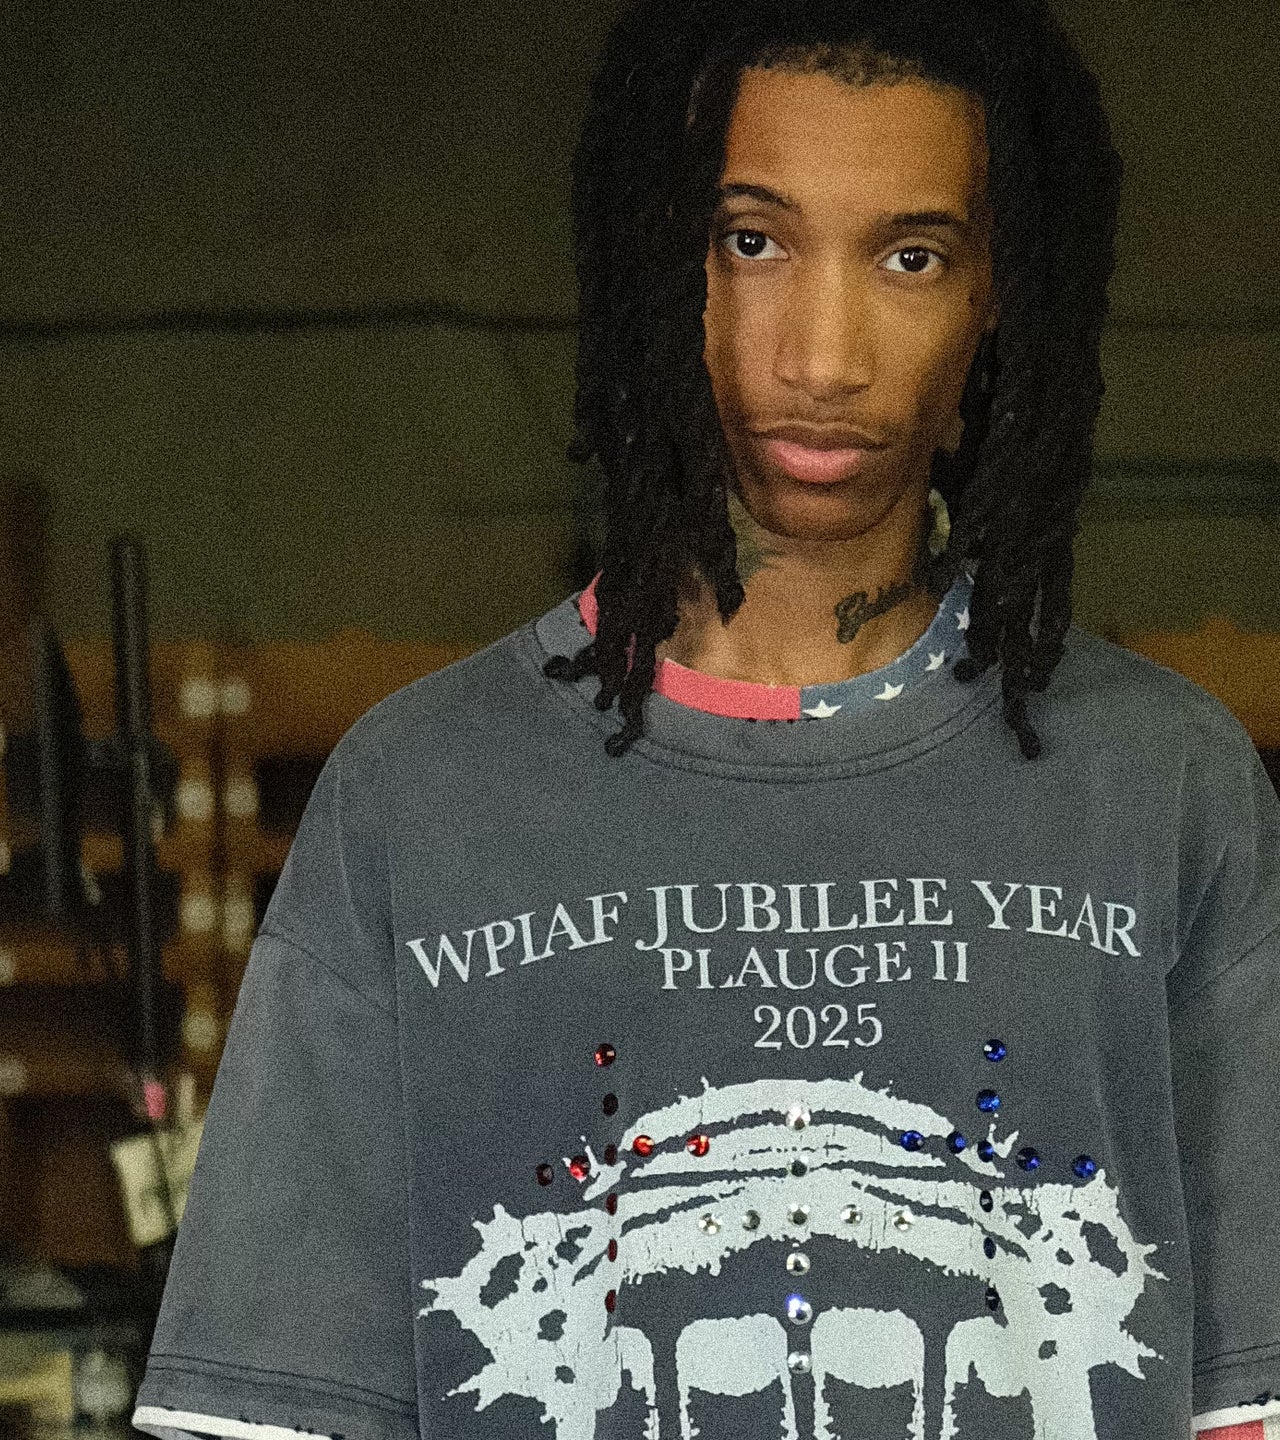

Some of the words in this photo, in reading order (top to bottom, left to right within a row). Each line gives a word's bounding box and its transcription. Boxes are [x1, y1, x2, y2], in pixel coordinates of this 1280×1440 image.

[405, 890, 629, 989] WPIAF
[634, 877, 954, 952] JUBILEE
[970, 879, 1141, 958] YEAR
[657, 940, 914, 991] PLAUGE
[930, 939, 970, 984] II
[752, 1003, 885, 1050] 2025
